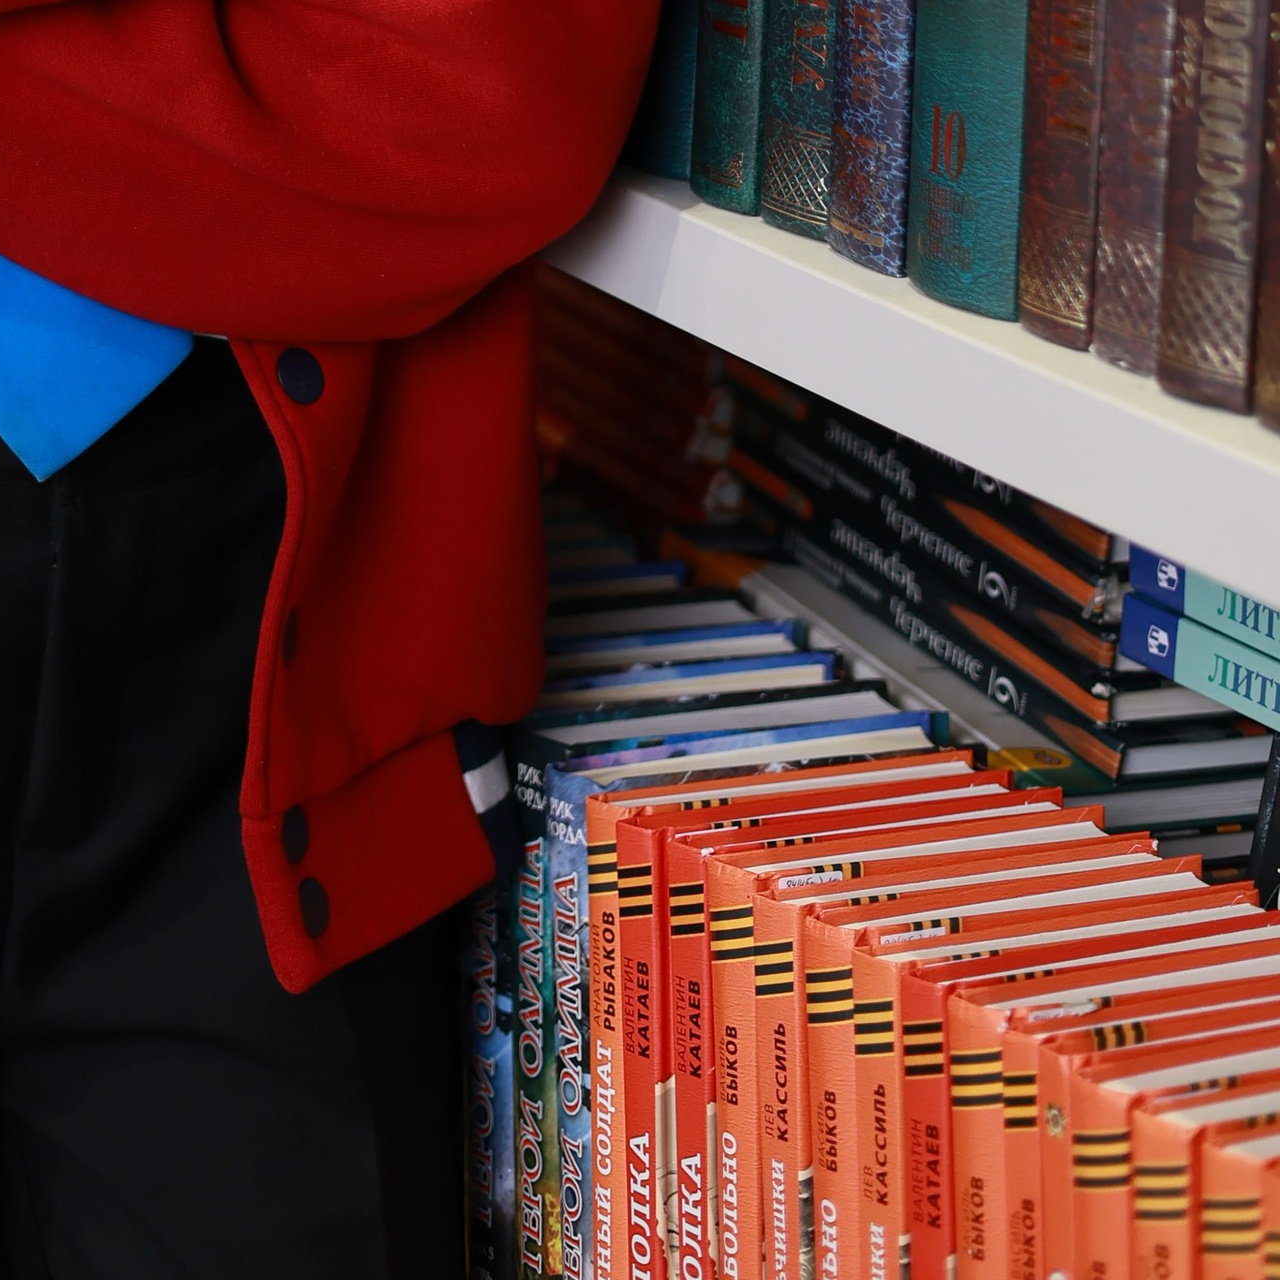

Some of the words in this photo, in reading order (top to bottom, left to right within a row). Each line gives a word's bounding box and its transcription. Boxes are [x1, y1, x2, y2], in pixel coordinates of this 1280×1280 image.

[930, 103, 967, 180] 10
[880, 494, 975, 578] Черчение
[889, 594, 984, 682] Черчение
[517, 762, 543, 787] РИК
[550, 797, 576, 821] РИК
[517, 838, 546, 1079] ОЛИМПА
[552, 872, 585, 1117] ОЛИМПА
[591, 923, 603, 1028] АНАТОЛИЙ
[602, 910, 617, 1032] РЫБАКОВ
[623, 956, 636, 1055] ВАЛЕНТИН
[636, 960, 651, 1060] КАТАЕВ
[675, 975, 687, 1074] ВАЛЕНТИН
[688, 980, 702, 1079] КАТАЕВ
[594, 1039, 615, 1177] СОЛДАТ
[725, 1025, 739, 1106] БЫКОВ
[774, 1022, 789, 1143] КАССИЛЬ
[470, 1056, 497, 1229] ГЕРОИ
[764, 1103, 775, 1139] ЛЕВ
[817, 1100, 826, 1169] ВАСИЛЬ
[824, 1090, 838, 1173] БЫКОВ
[873, 1083, 889, 1207] КАССИЛЬ
[518, 1098, 545, 1276] ГЕРОИ
[559, 1132, 585, 1280] ЕРОИ
[722, 1131, 738, 1279] БОЛЬНО
[863, 1165, 873, 1202] ЛЕВ
[910, 1118, 924, 1224] ВАЛЕНТИН
[925, 1124, 941, 1230] КАТАЕВ
[970, 1176, 985, 1262] БЫКОВ
[821, 1198, 838, 1280] ЬНО
